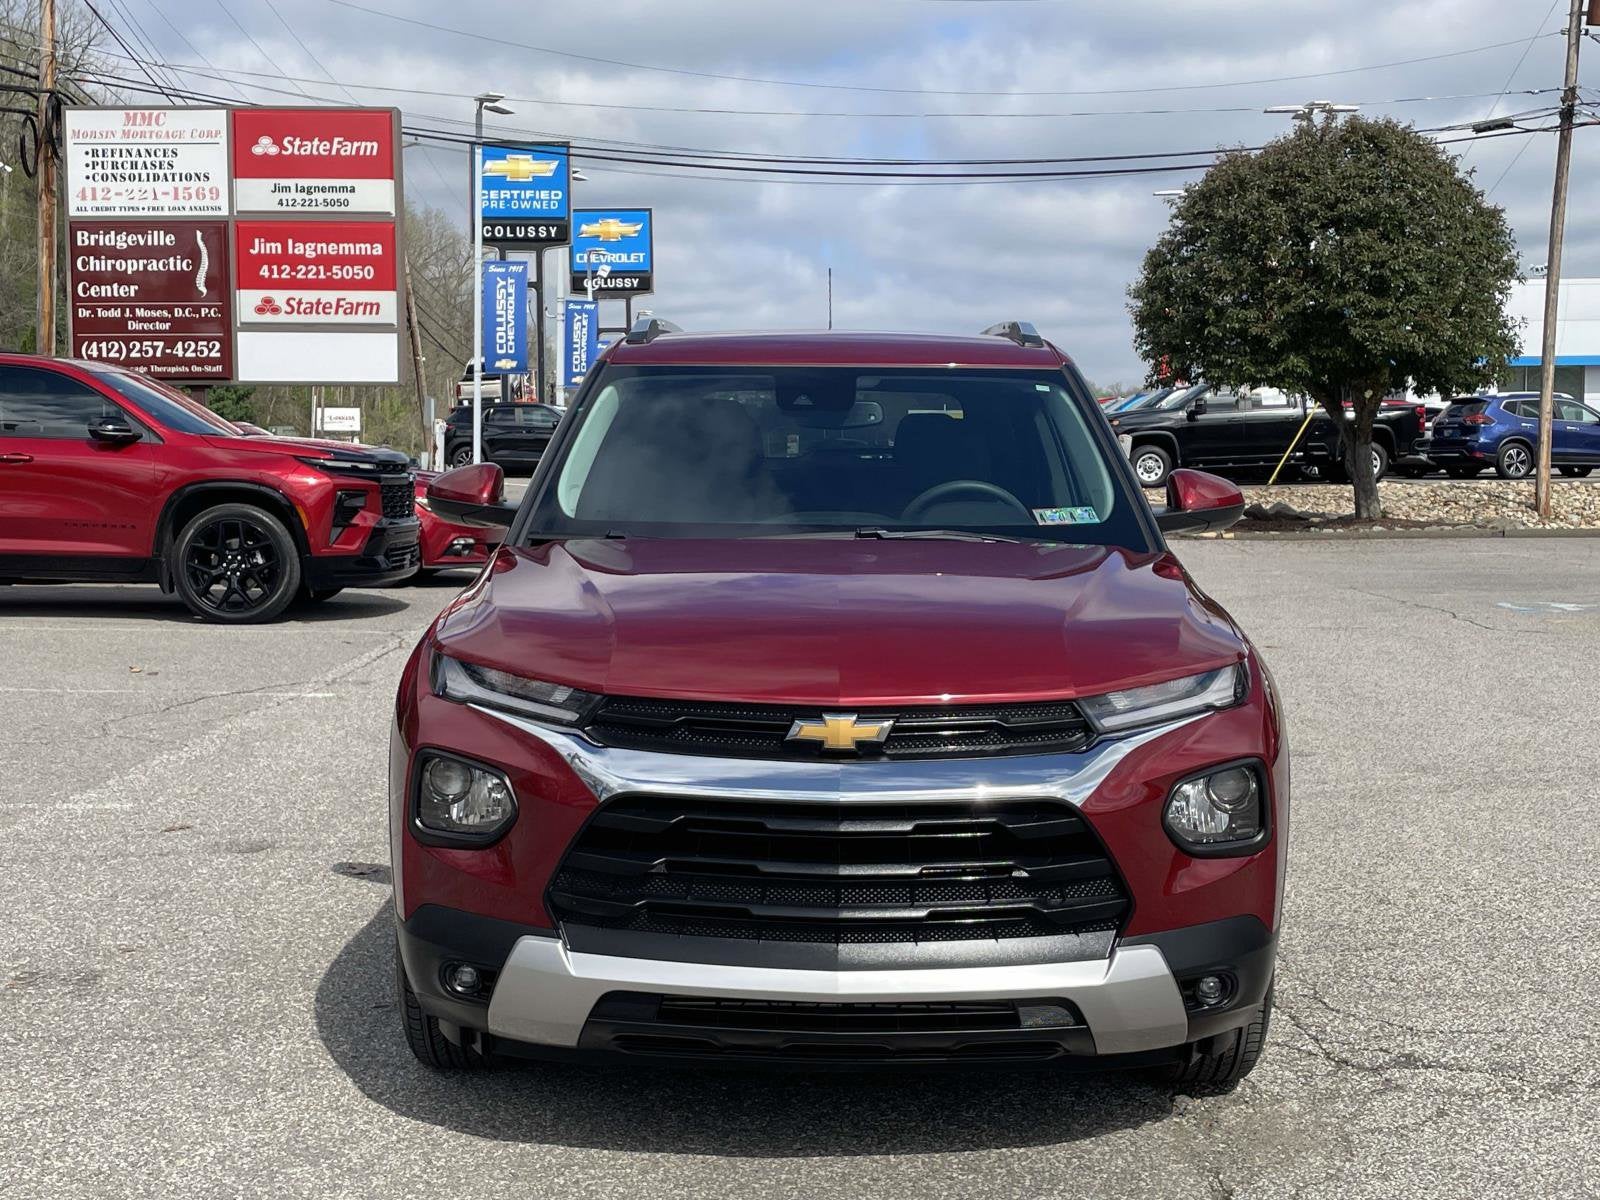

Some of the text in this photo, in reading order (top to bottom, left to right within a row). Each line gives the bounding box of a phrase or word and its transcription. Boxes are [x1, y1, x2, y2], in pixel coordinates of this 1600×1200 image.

[123, 111, 167, 127] MMC
[121, 129, 186, 140] MORTGAGE
[91, 148, 179, 159] REFINANCES
[91, 160, 175, 171] PURCHASES
[92, 172, 211, 182] CONSOLIDATIONS
[76, 186, 220, 201] 412-221-1569
[271, 183, 356, 196] Jim Iagnemma
[481, 190, 563, 200] CERTIFIED
[277, 198, 350, 208] 412-221-5050
[482, 200, 559, 209] PRE-OWNED
[483, 226, 558, 238] COLUSSY
[76, 230, 176, 250] Bridgeville
[249, 238, 383, 258] Jim Iagnemma
[76, 255, 193, 275] Chiropractic
[259, 264, 375, 280] 412-221-5050
[77, 281, 139, 298] Center
[78, 308, 94, 318] Dr.
[97, 308, 121, 318] Todd
[124, 308, 133, 318] J.
[135, 308, 171, 319] Moses,
[495, 276, 507, 354] COLUSSY
[506, 276, 516, 354] CHEVROLET
[127, 321, 172, 331] Director
[572, 312, 582, 373] COLUSSY
[580, 312, 589, 373] CHEVROLET
[81, 341, 221, 361] (412) 257-4252
[150, 365, 189, 374] Therapists
[191, 365, 223, 373] On-Staff
